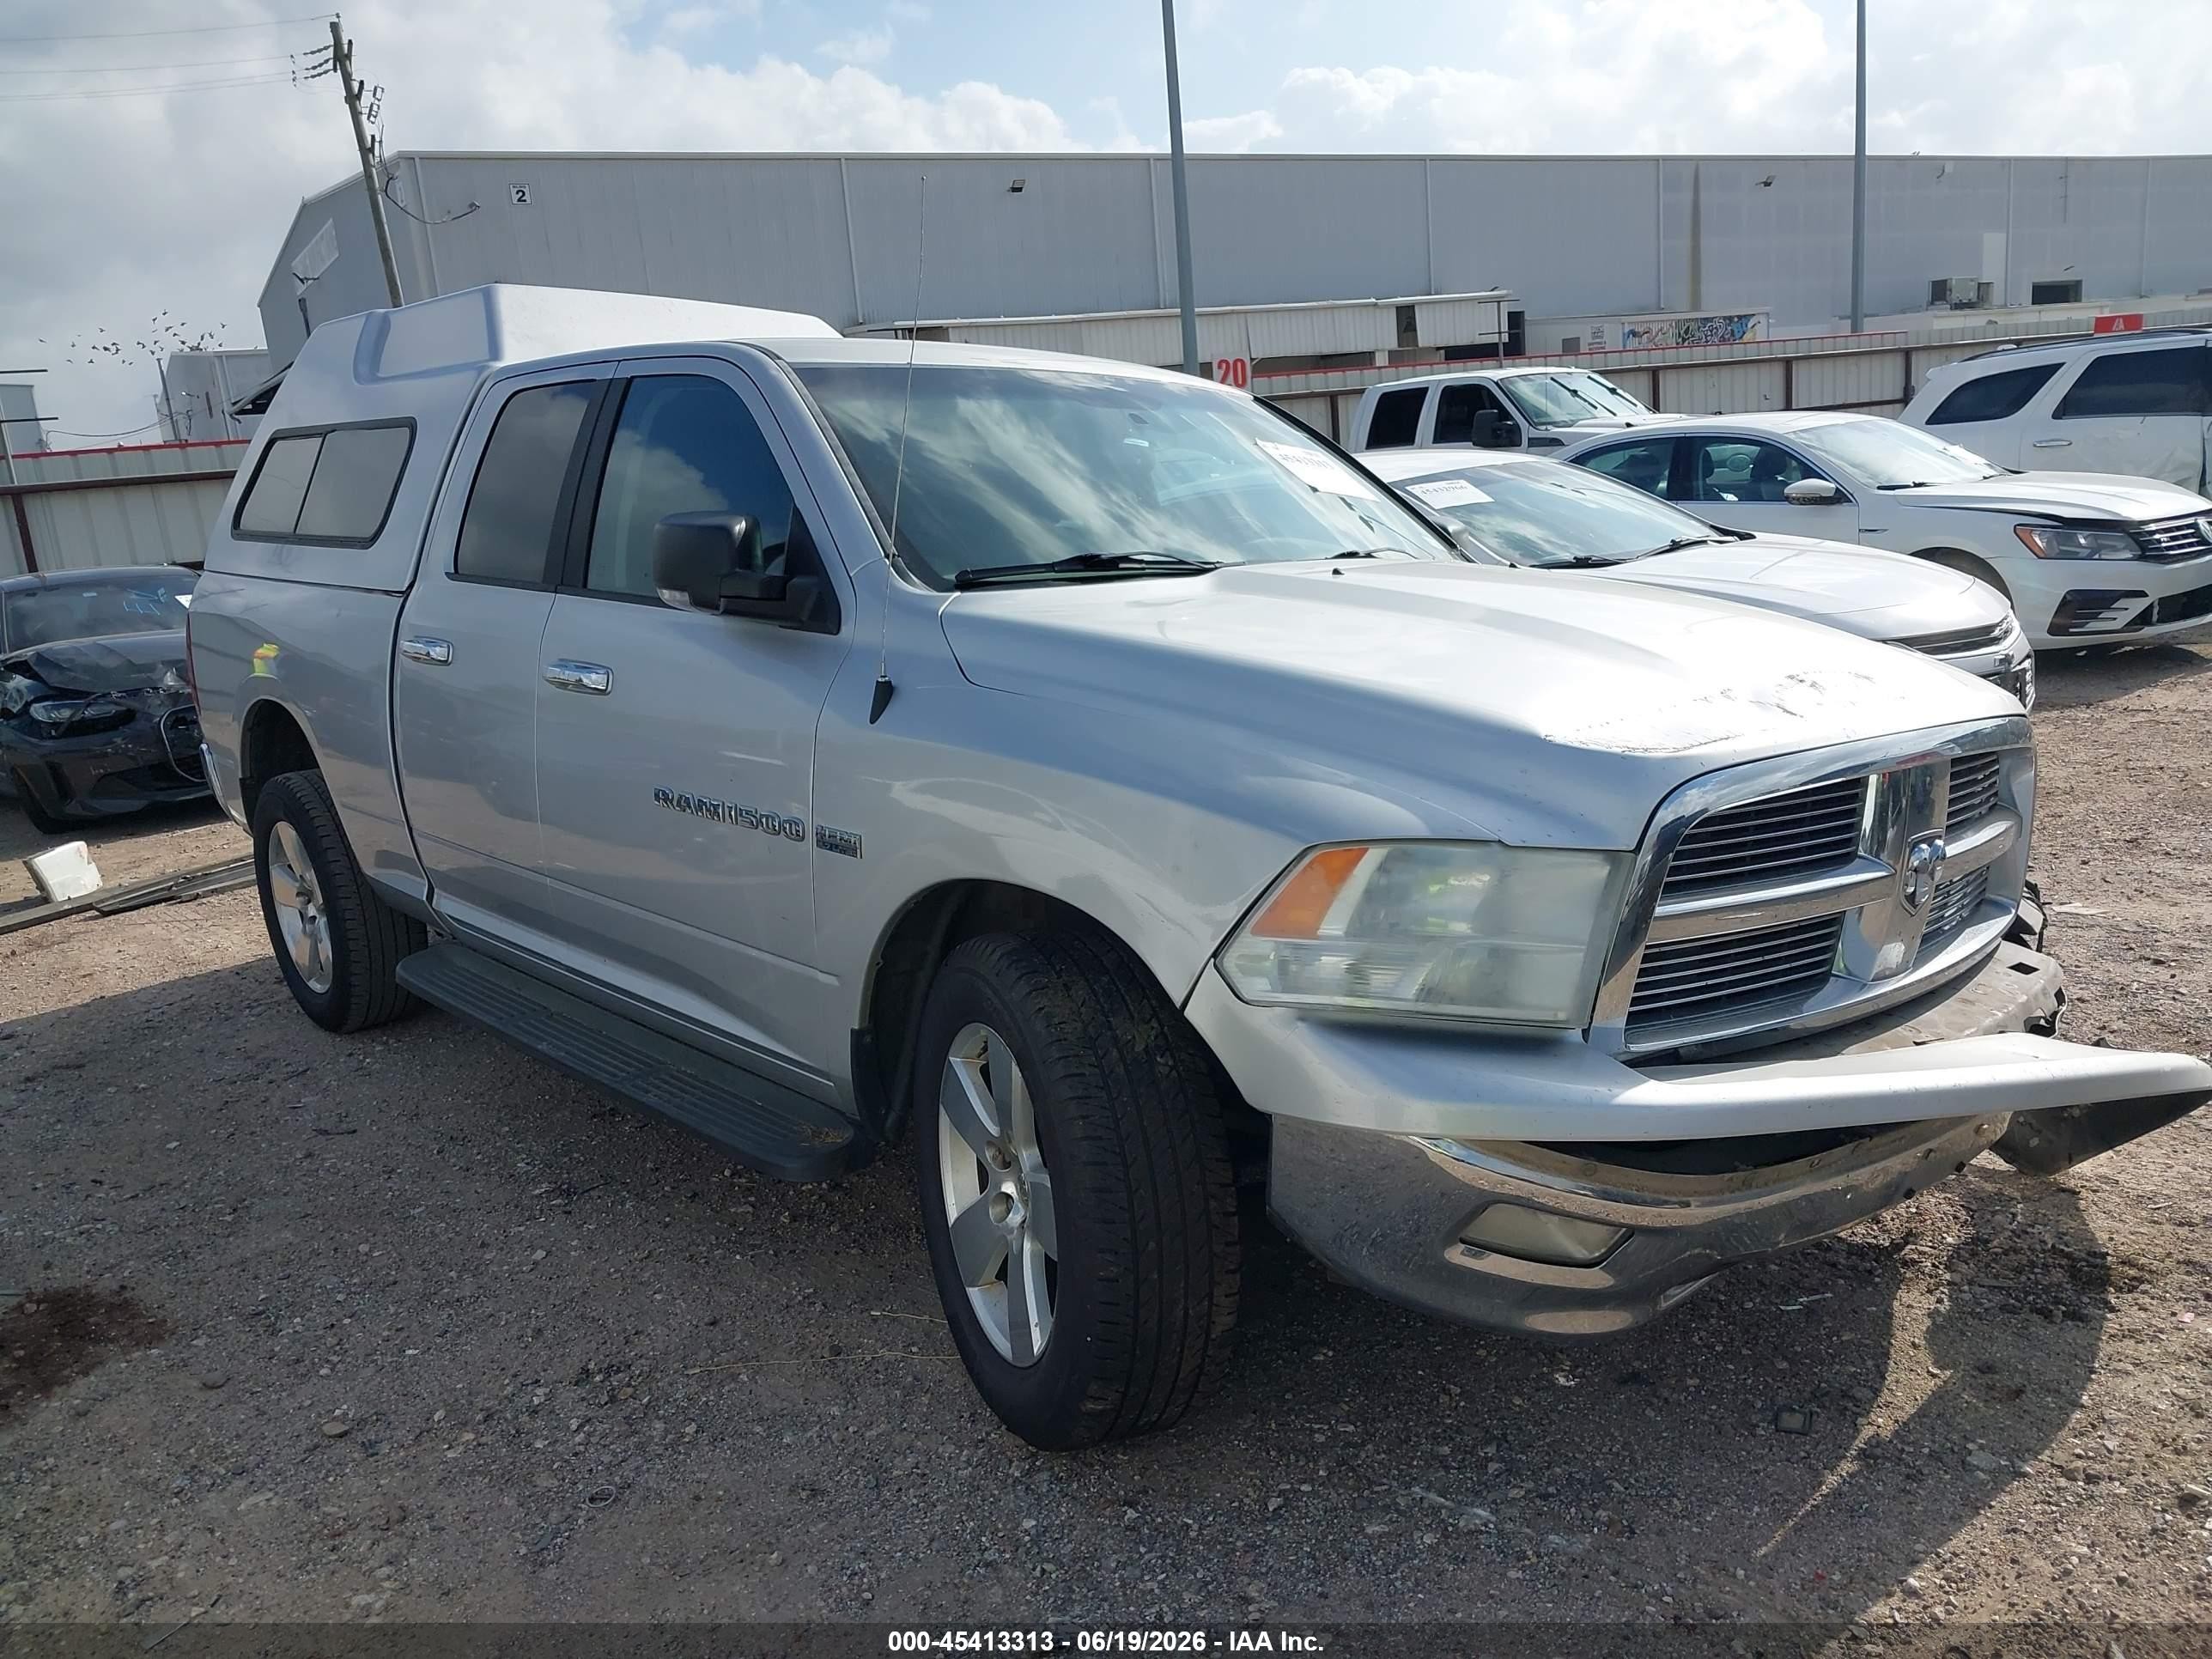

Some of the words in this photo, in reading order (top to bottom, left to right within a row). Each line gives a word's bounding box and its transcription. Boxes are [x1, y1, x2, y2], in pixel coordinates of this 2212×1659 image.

[515, 189, 527, 203] 2
[1217, 358, 1247, 388] 20
[653, 785, 726, 823] RAM
[727, 803, 805, 842] 1500
